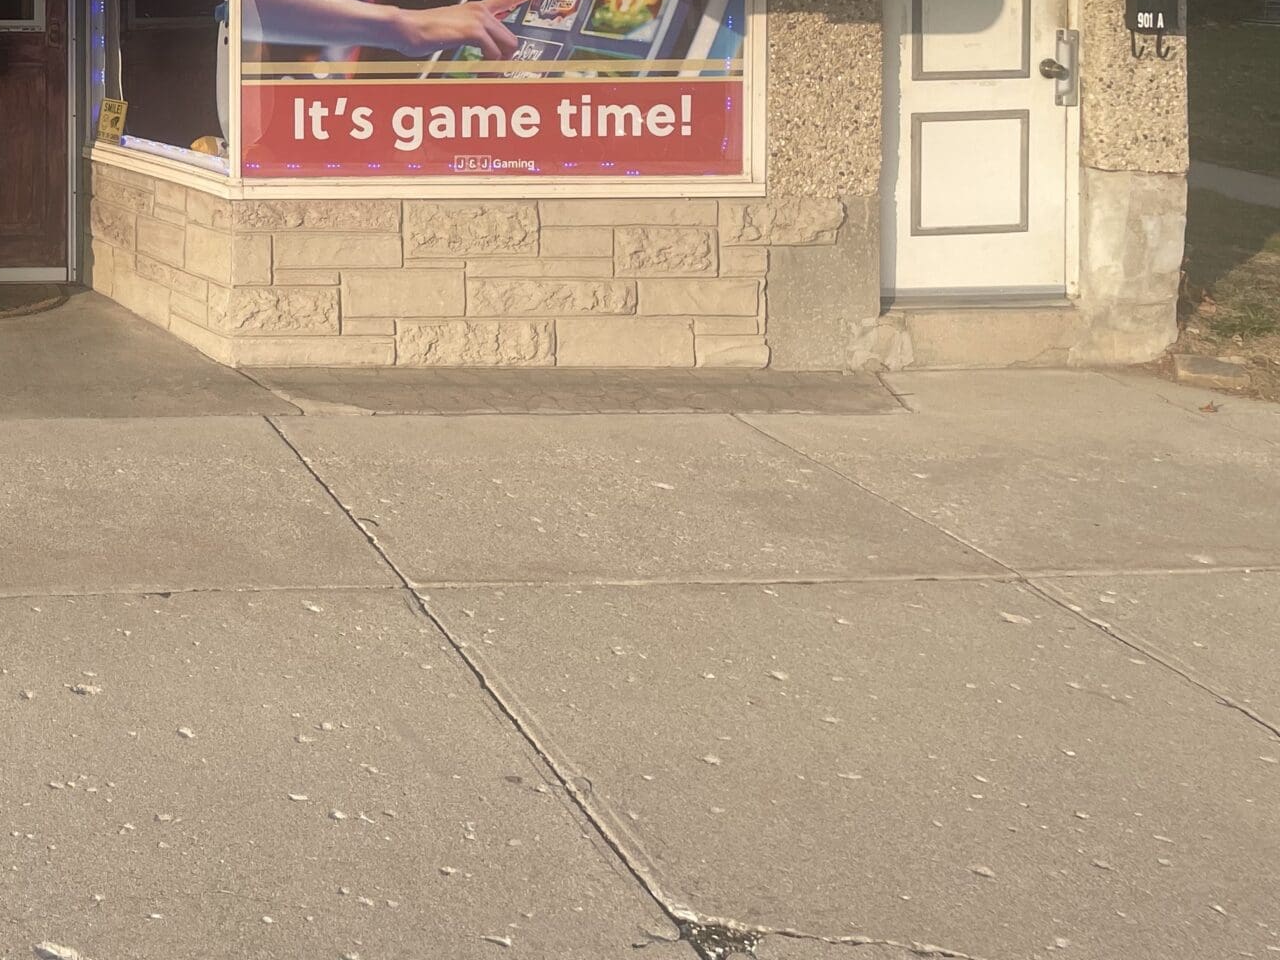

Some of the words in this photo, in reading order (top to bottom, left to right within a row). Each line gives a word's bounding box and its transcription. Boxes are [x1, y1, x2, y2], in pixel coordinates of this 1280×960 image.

[1137, 12, 1154, 28] 901
[1157, 12, 1164, 29] A
[294, 97, 373, 140] It's
[391, 104, 541, 152] game
[557, 94, 692, 138] time!
[493, 158, 535, 171] Gaming
